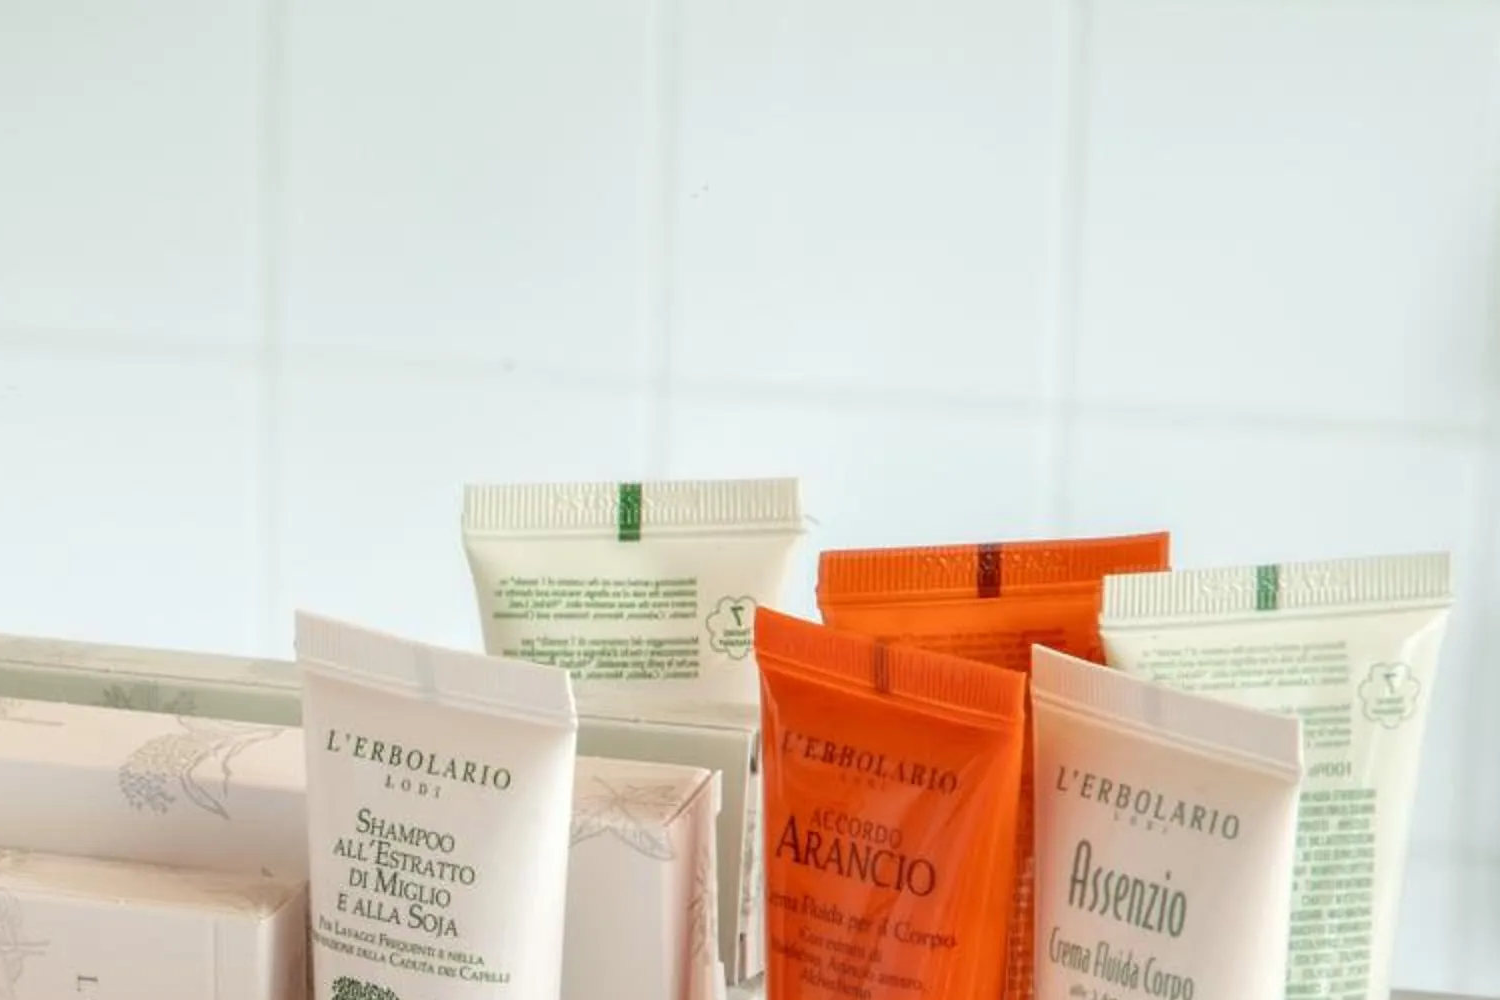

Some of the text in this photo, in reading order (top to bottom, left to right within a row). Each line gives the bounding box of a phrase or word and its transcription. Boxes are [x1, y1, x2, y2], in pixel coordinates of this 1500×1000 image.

[327, 729, 512, 790] L'ERBOLARIO
[782, 730, 958, 795] L'ERBOLARIO
[385, 774, 442, 799] LODI
[1056, 766, 1241, 840] L'ERBOLARIO
[356, 808, 455, 853] SHAMPOO
[775, 814, 936, 897] ARANCIO
[809, 808, 903, 850] ACCORDO
[348, 867, 451, 908] DI MIGLIO
[1068, 839, 1188, 938] Assenzio
[337, 893, 458, 937] E ALLA SOJA
[894, 918, 958, 951] Corpo
[1049, 926, 1091, 974] Crema
[1093, 940, 1140, 990] Fluida
